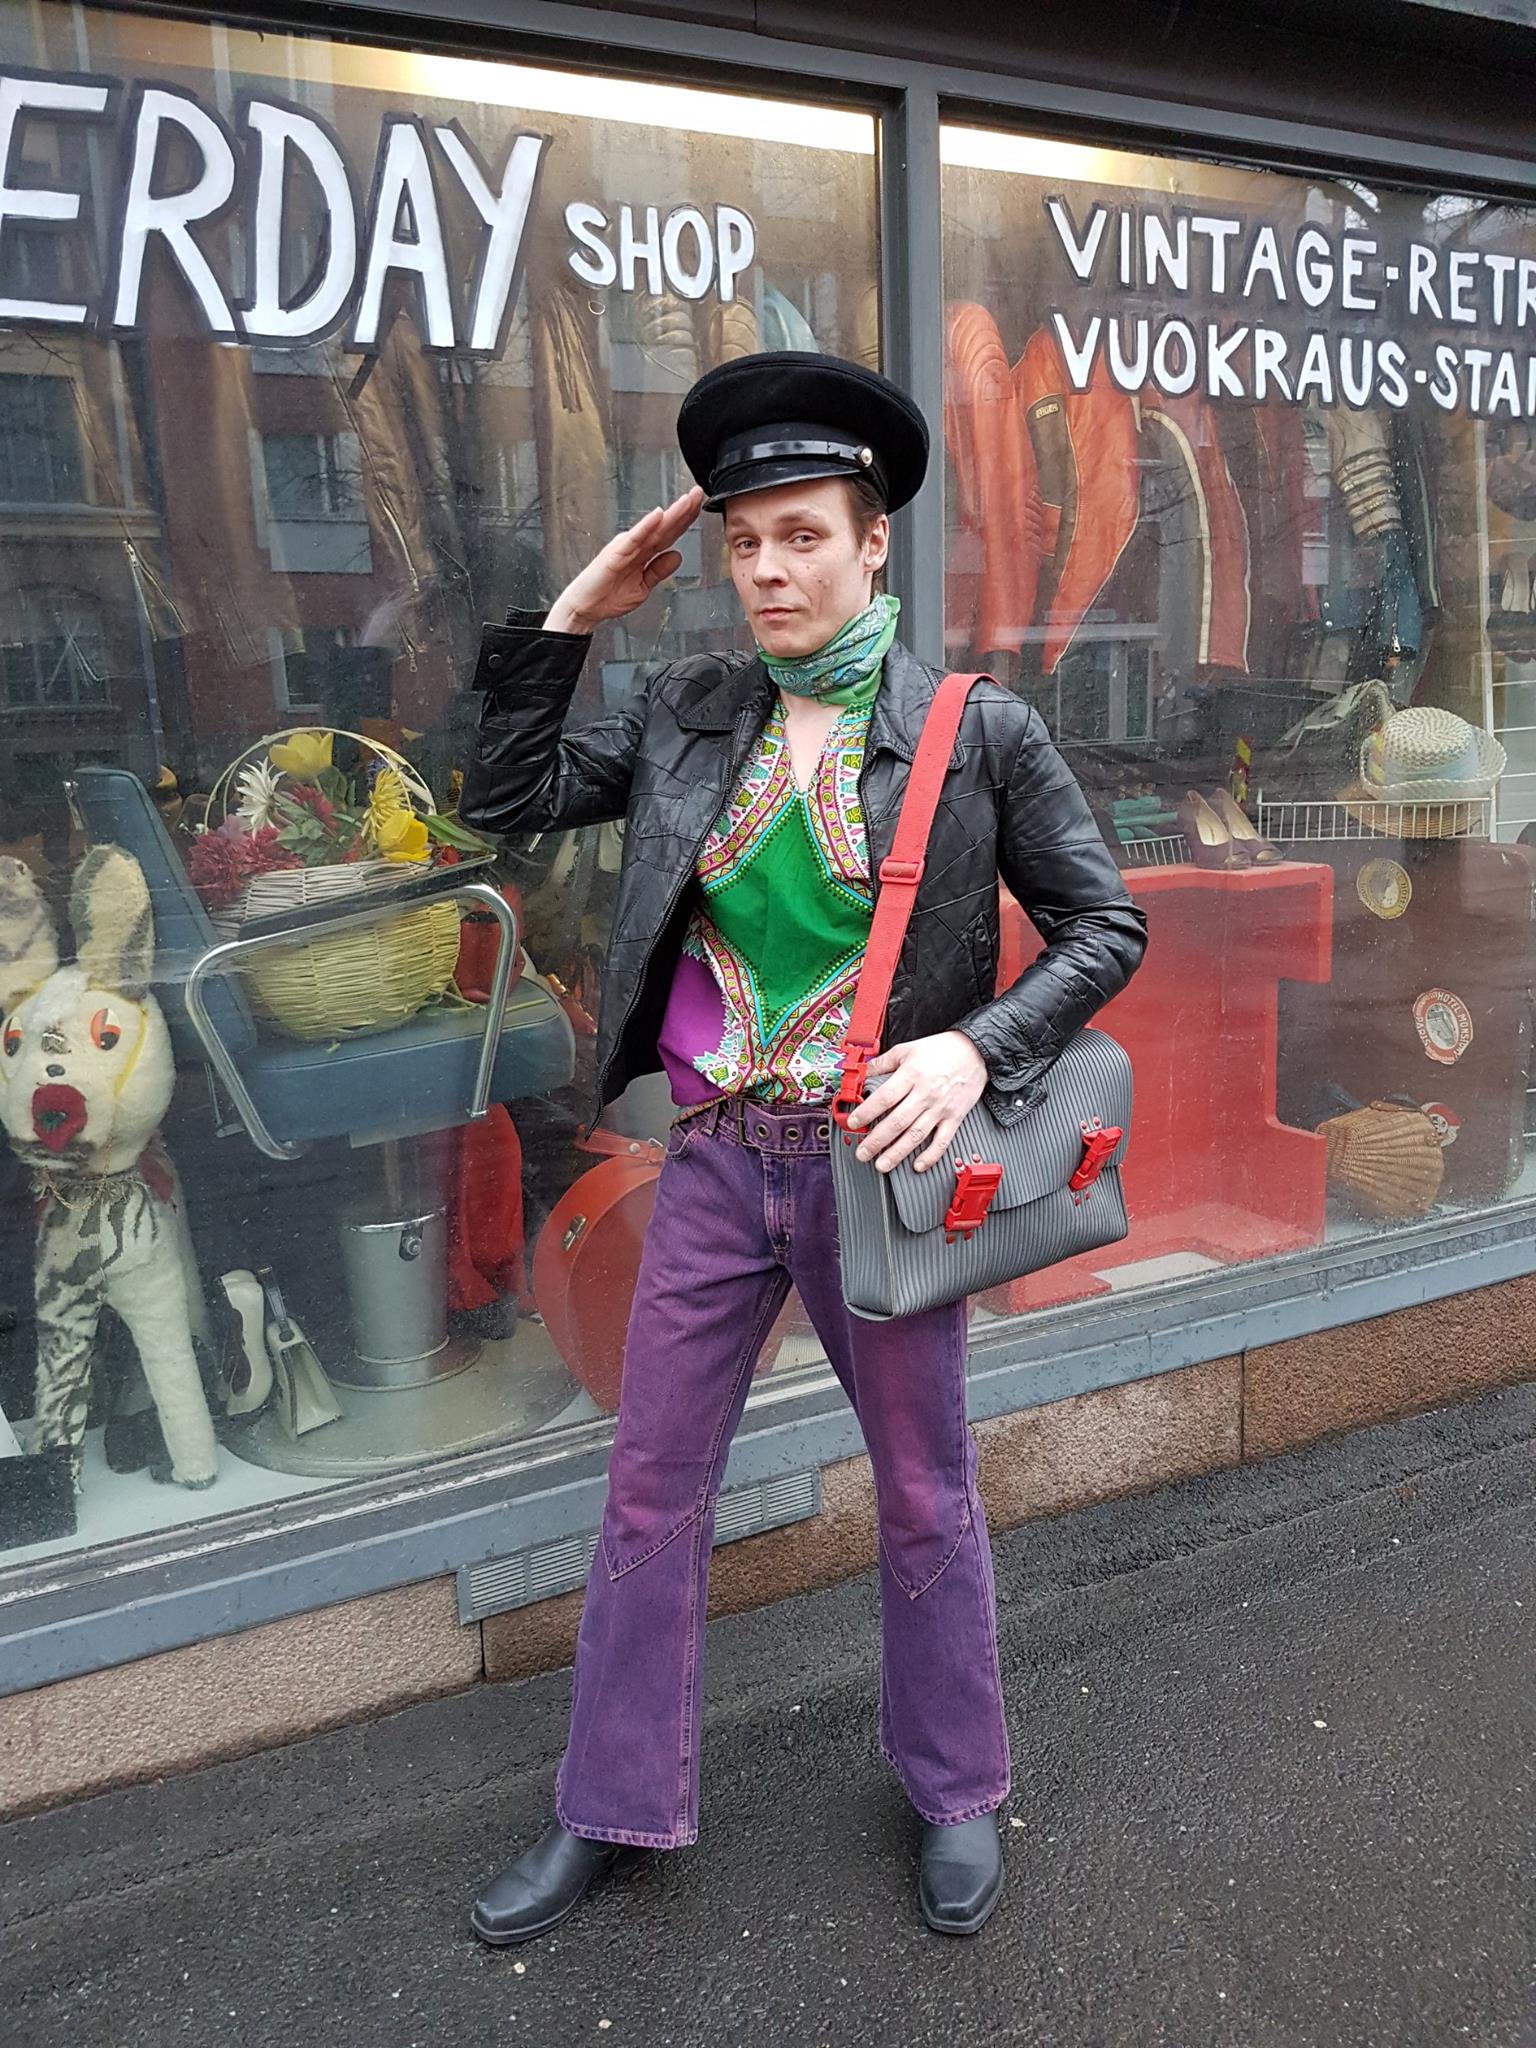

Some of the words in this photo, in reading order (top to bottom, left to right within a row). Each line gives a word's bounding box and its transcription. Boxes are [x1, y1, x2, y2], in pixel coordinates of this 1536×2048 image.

[0, 76, 544, 350] ERDAY
[564, 203, 756, 301] SHOP
[1437, 991, 1461, 1014] HOTEL
[1416, 1016, 1431, 1047] PARIS
